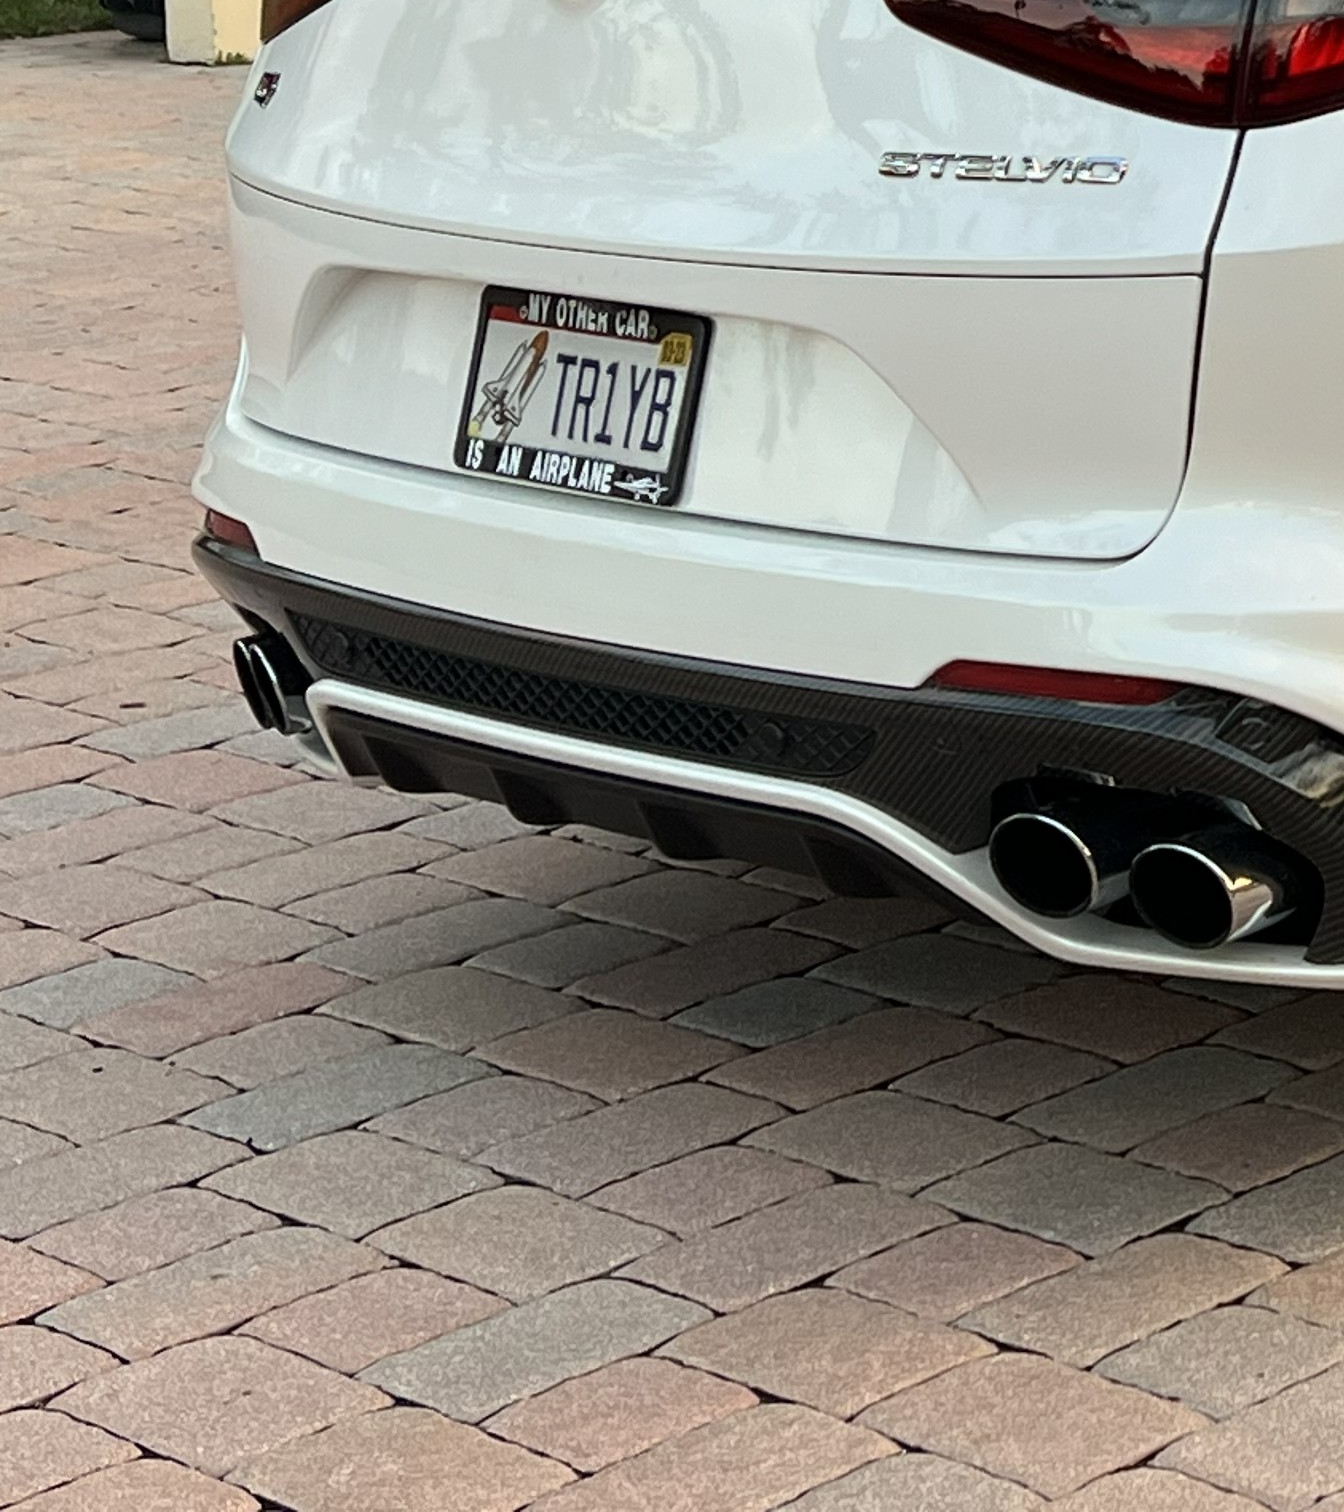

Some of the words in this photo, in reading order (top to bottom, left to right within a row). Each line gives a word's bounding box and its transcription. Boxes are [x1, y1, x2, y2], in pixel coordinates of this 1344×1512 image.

[878, 151, 1130, 184] STELVIO
[526, 293, 551, 323] MY
[556, 297, 608, 334] OTHER
[615, 308, 650, 339] CAR
[465, 439, 484, 469] IS
[496, 444, 523, 476] AN
[529, 450, 616, 494] AIRPLANE
